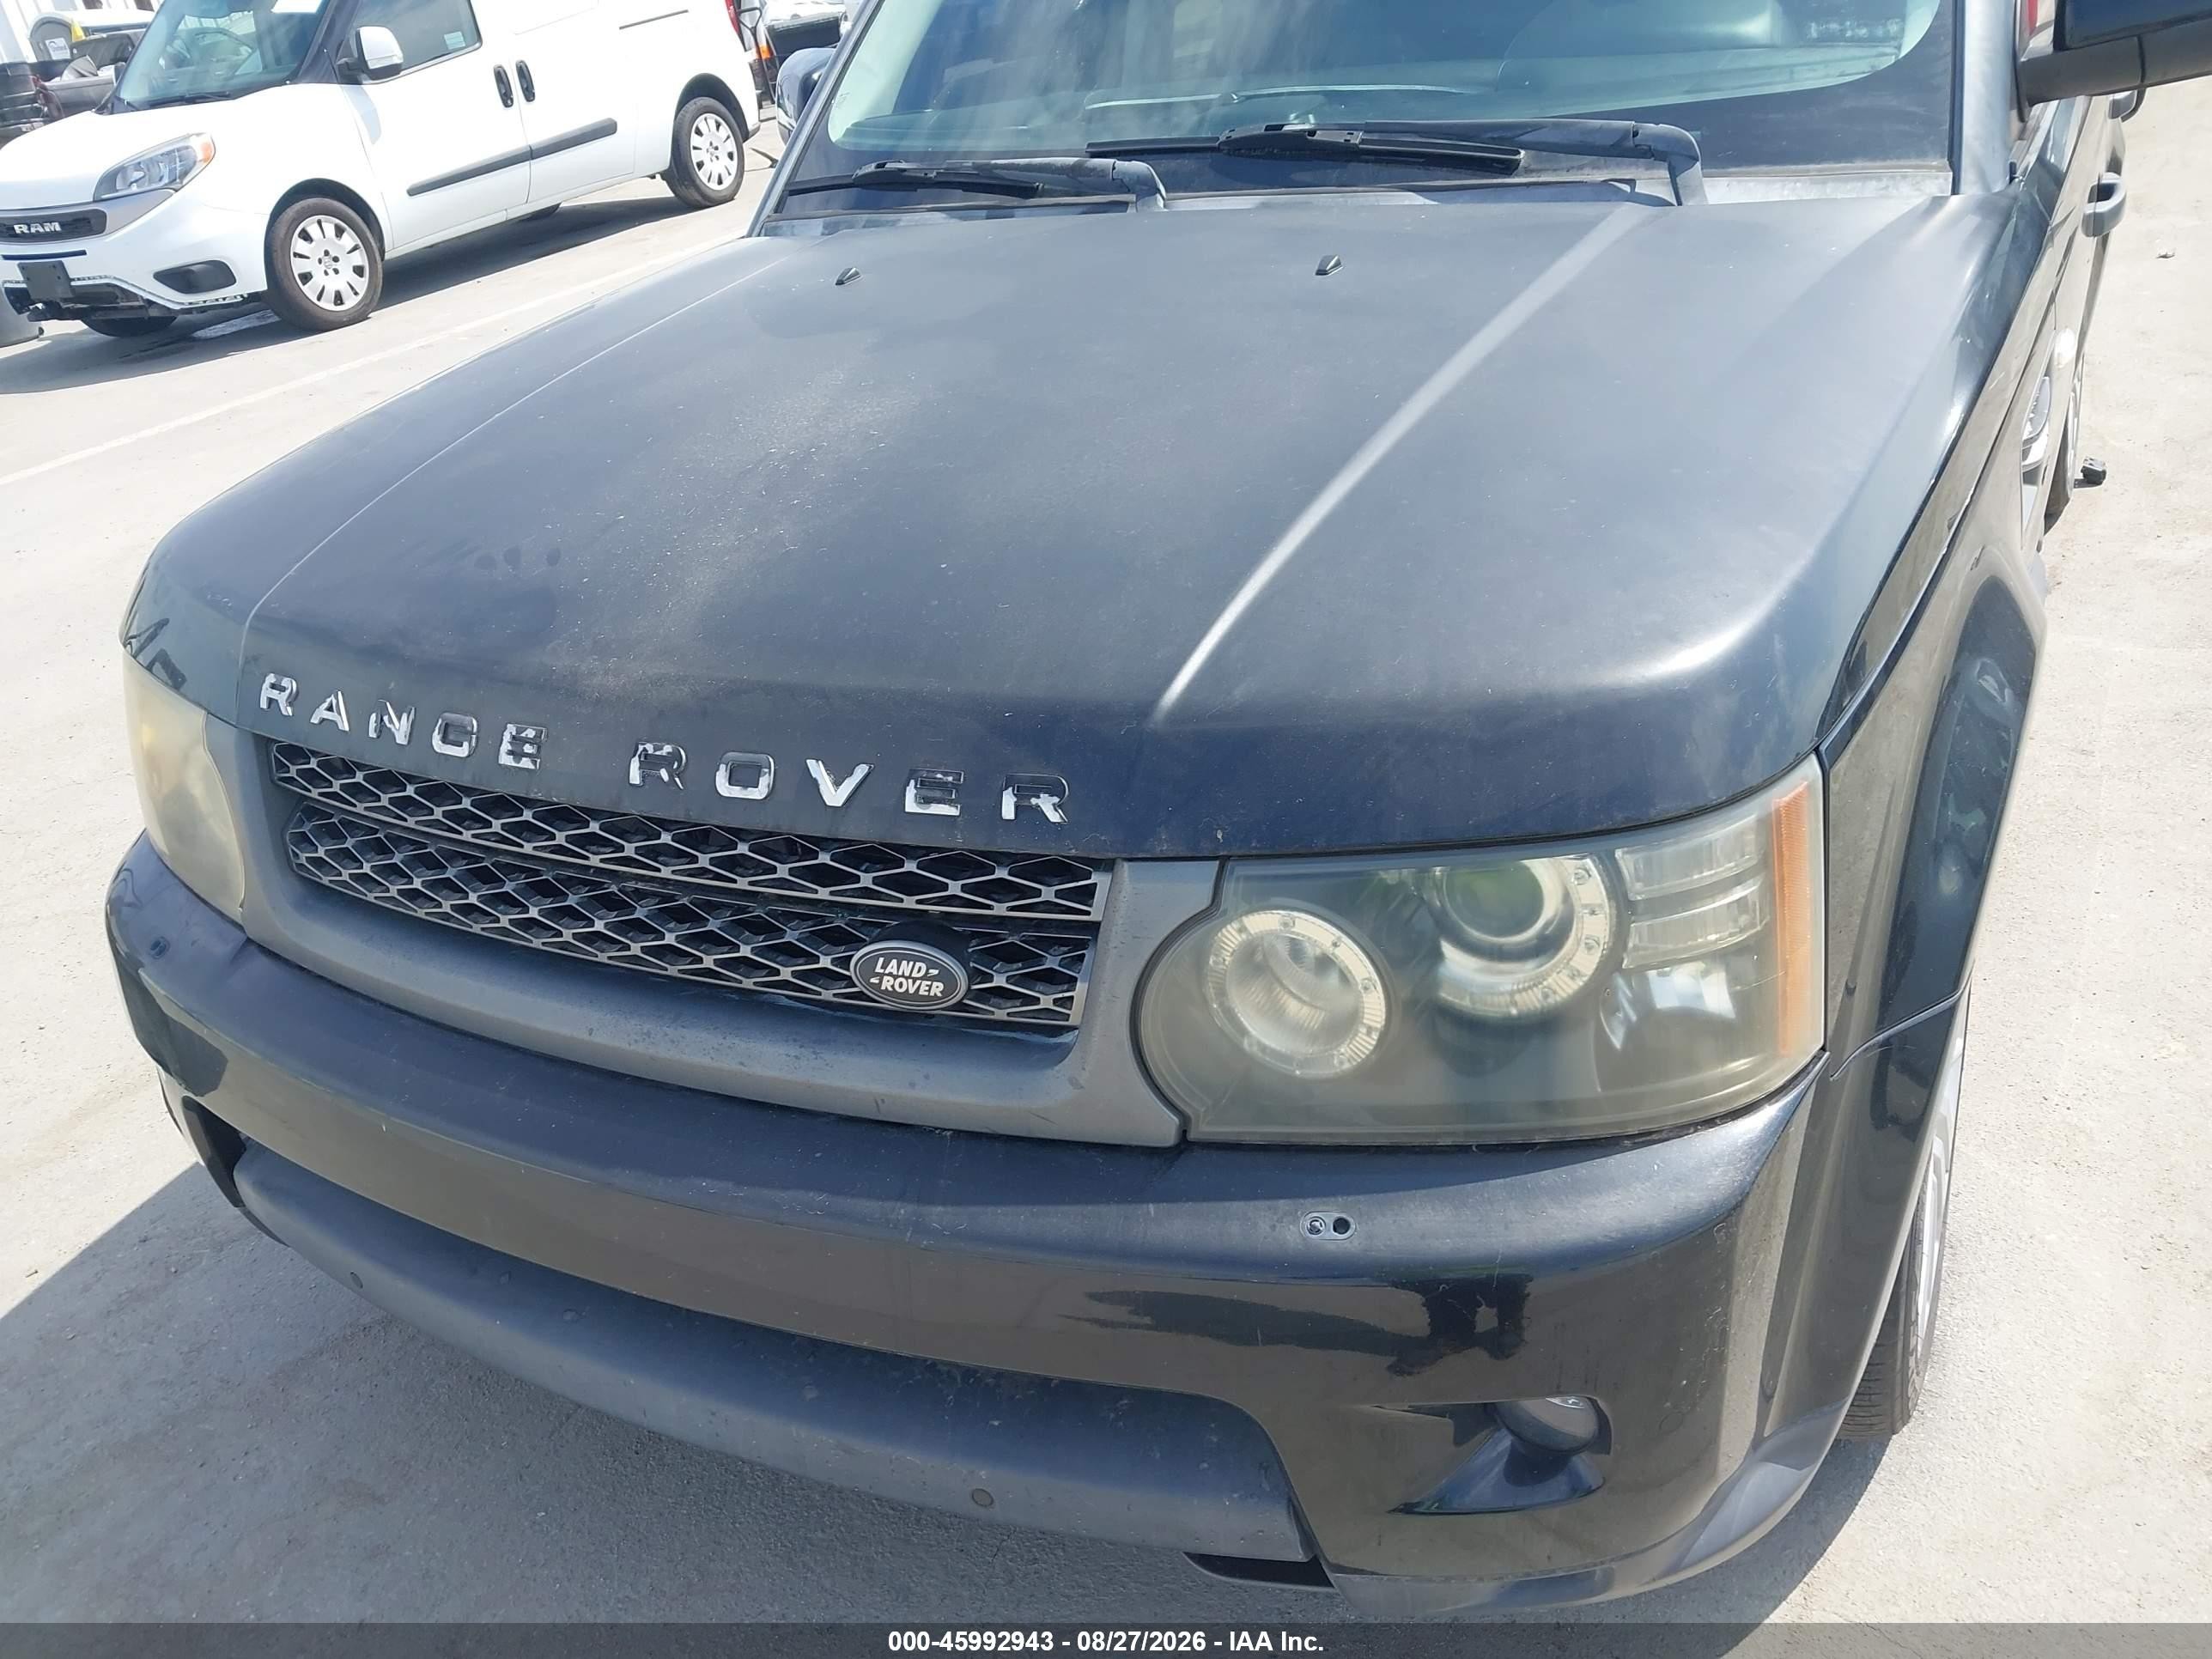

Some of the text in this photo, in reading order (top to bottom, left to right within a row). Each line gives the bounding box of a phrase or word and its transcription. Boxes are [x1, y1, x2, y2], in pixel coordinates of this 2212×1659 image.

[14, 222, 62, 234] RAM
[259, 672, 1070, 824] RANGE ROVER
